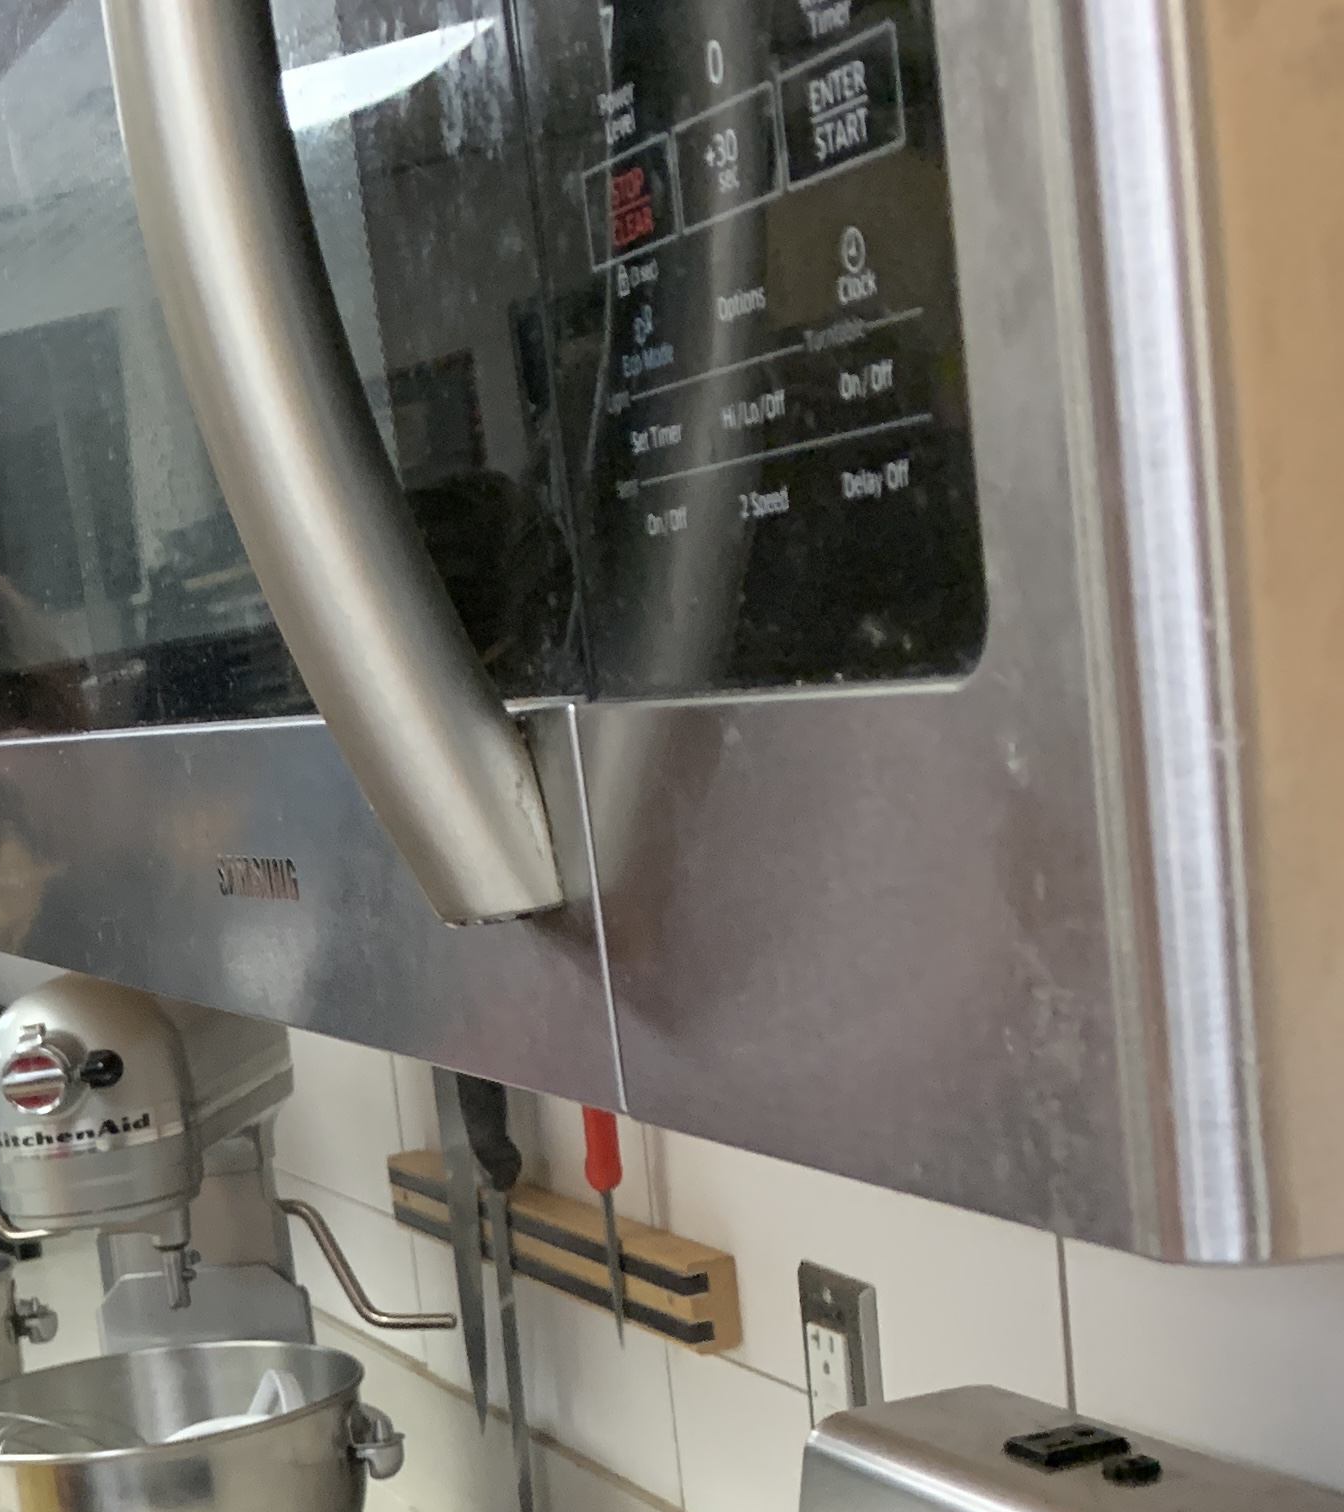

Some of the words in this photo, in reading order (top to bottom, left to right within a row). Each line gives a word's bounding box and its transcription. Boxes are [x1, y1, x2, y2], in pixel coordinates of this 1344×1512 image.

[706, 39, 724, 85] 0
[809, 60, 867, 113] ENTER
[704, 128, 738, 167] +30
[814, 107, 868, 162] START
[716, 286, 766, 322] Options
[837, 271, 877, 306] Clock
[648, 422, 683, 448] Timer
[841, 470, 883, 500] Delay
[884, 458, 910, 491] Off
[738, 494, 750, 519] 2
[751, 485, 790, 518] Speed
